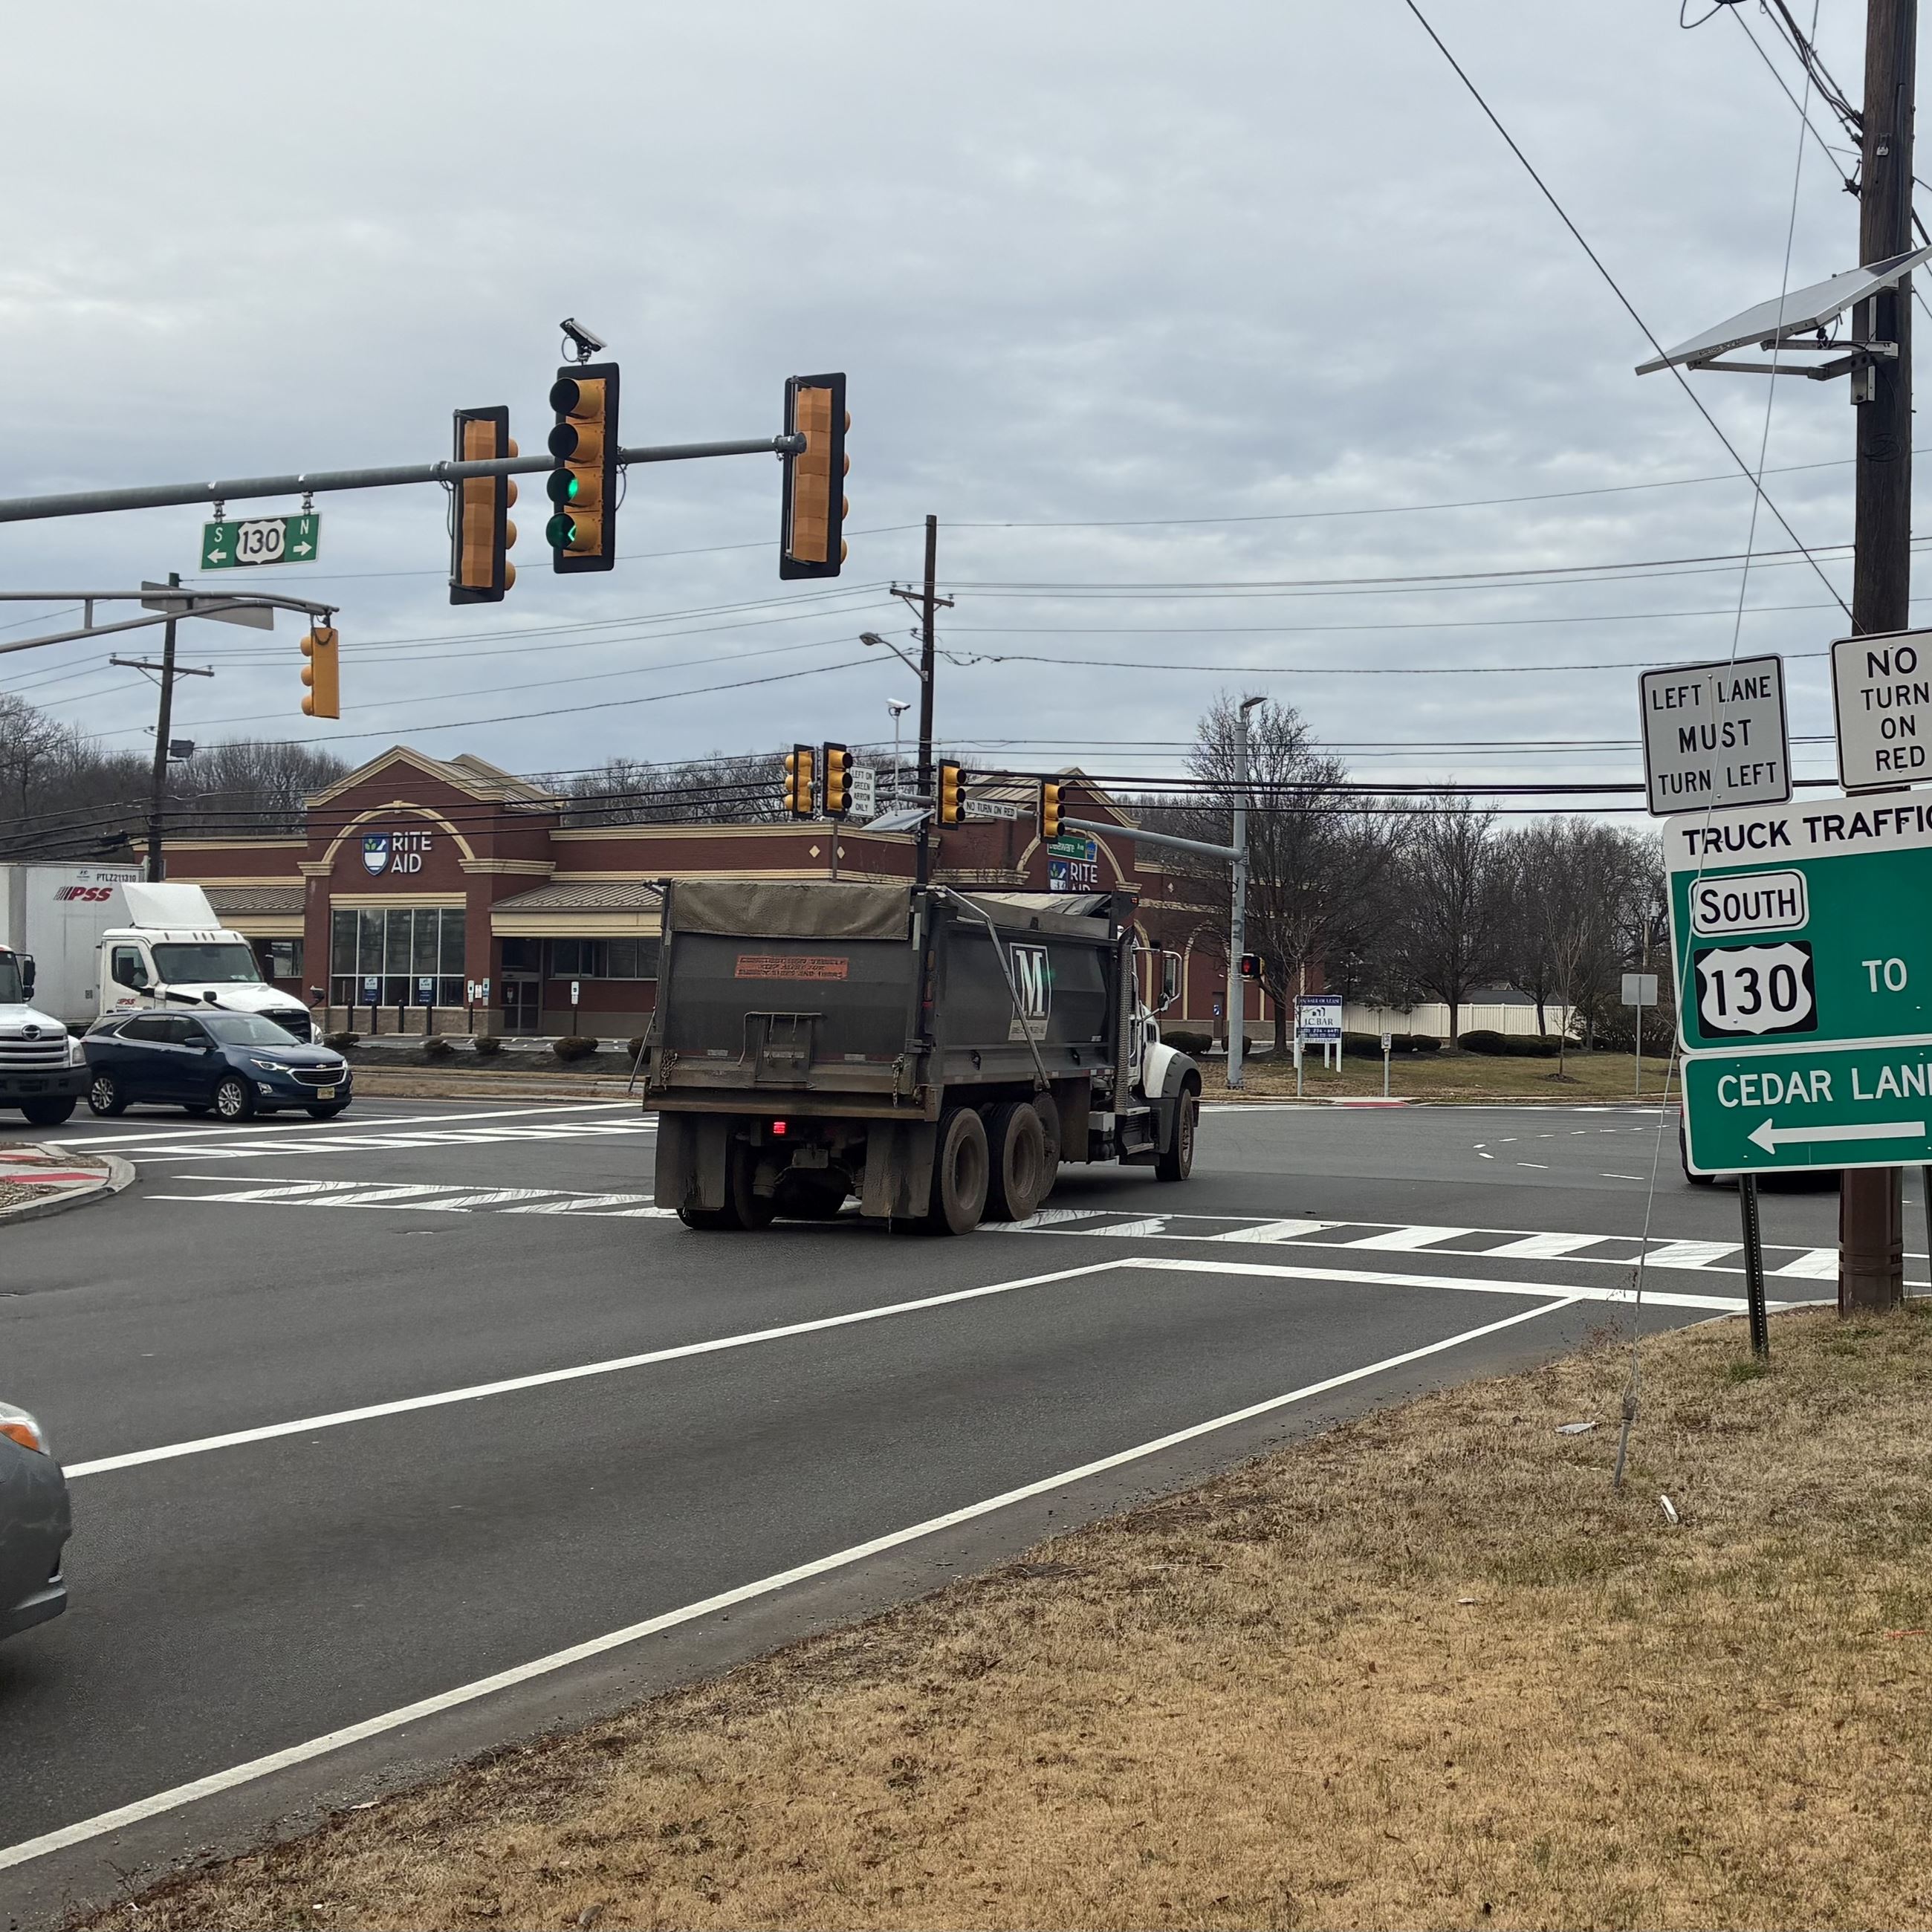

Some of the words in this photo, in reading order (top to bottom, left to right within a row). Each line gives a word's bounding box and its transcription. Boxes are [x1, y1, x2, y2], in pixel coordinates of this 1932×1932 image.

[214, 527, 223, 542] S
[242, 528, 280, 554] 130
[300, 519, 309, 534] N
[1867, 646, 1917, 678] NO
[1652, 684, 1702, 710] LEFT
[1717, 675, 1771, 703] LANE
[1860, 681, 1930, 711] TURN
[1678, 719, 1752, 753] MUST
[1881, 714, 1916, 739] ON
[1876, 745, 1925, 771] RED
[1658, 768, 1712, 795] TURN
[1726, 762, 1777, 788] LEFT
[966, 802, 975, 811] NO
[977, 803, 992, 813] TURN
[993, 805, 1002, 814] ON
[392, 831, 432, 851] RITE
[1682, 819, 1792, 856] TRUCK
[1803, 804, 1932, 843] TRAFFI
[391, 853, 422, 873] AID
[1070, 862, 1098, 884] RITE
[1700, 887, 1797, 924] SOUTH
[1016, 950, 1045, 1017] M
[1711, 964, 1798, 1017] 130
[1861, 957, 1908, 993] TO
[1717, 1069, 1834, 1108] CEDAR
[1851, 1063, 1932, 1100] LAN
